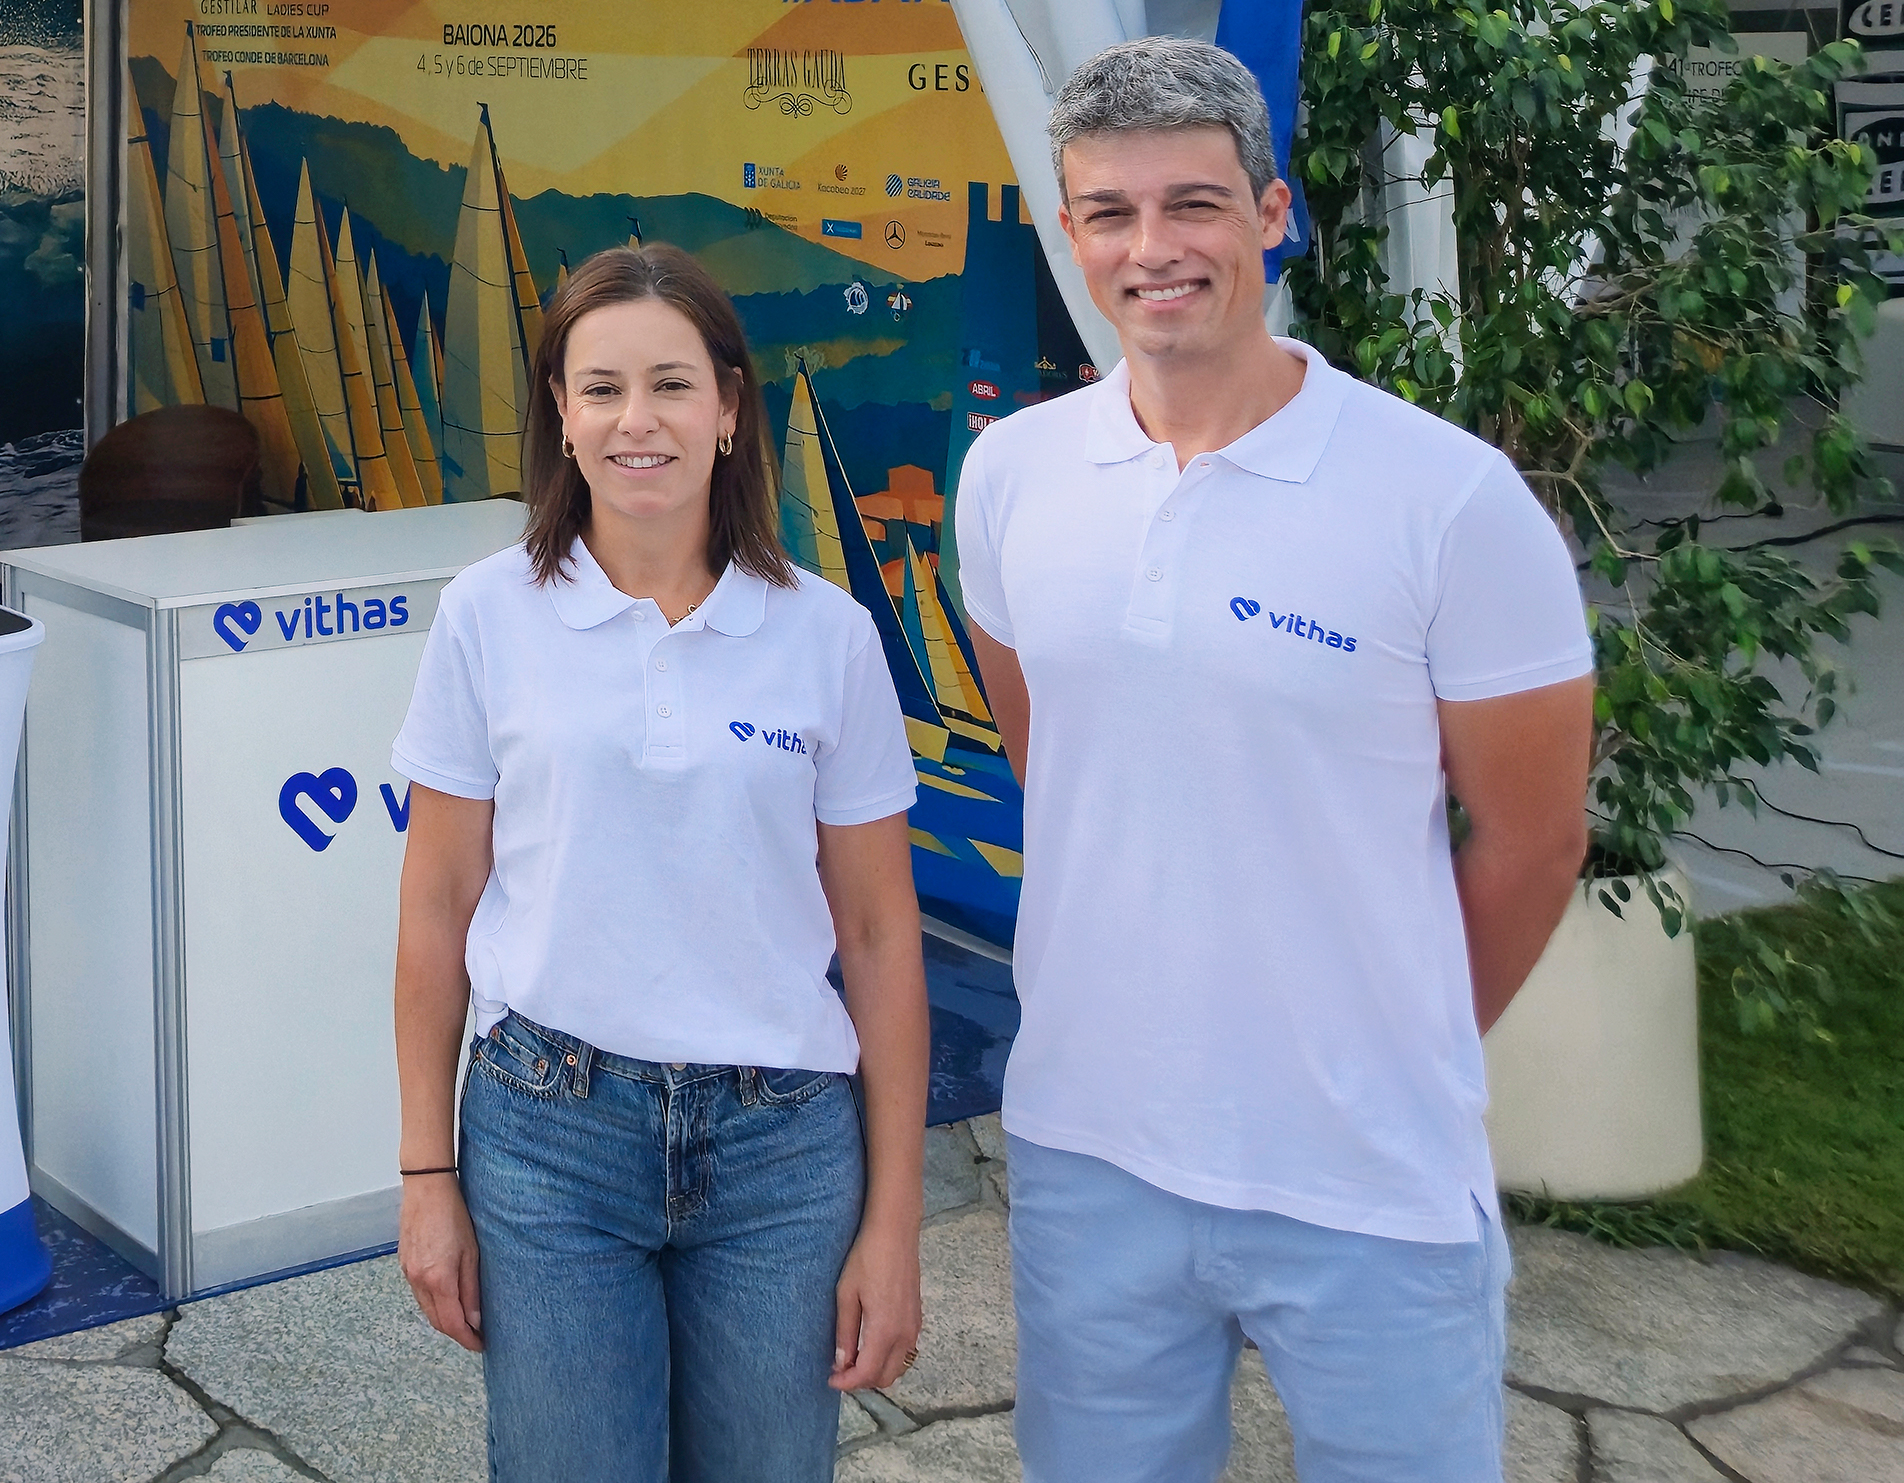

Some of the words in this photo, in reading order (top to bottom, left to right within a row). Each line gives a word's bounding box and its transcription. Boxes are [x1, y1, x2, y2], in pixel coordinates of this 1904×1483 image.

[266, 3, 304, 16] LADIES
[306, 3, 330, 17] CUP
[196, 24, 227, 37] TROFEO
[228, 24, 280, 38] PRESIDENTE
[281, 25, 292, 38] DE
[293, 25, 305, 39] LA
[305, 25, 337, 40] XUNTA
[443, 23, 509, 47] BAIONA
[512, 23, 557, 48] 2026
[201, 49, 234, 63] TROFEO
[234, 50, 263, 64] CONDE
[264, 51, 276, 65] DE
[277, 52, 330, 67] BARCELONA
[434, 54, 443, 74] 5
[445, 59, 454, 78] y
[456, 55, 465, 75] 6
[467, 55, 484, 76] de
[487, 55, 588, 80] SEPTIEMBRE
[908, 63, 984, 93] GES
[971, 383, 997, 398] ABRIL
[275, 593, 409, 641] vithas
[1268, 611, 1358, 652] vithas
